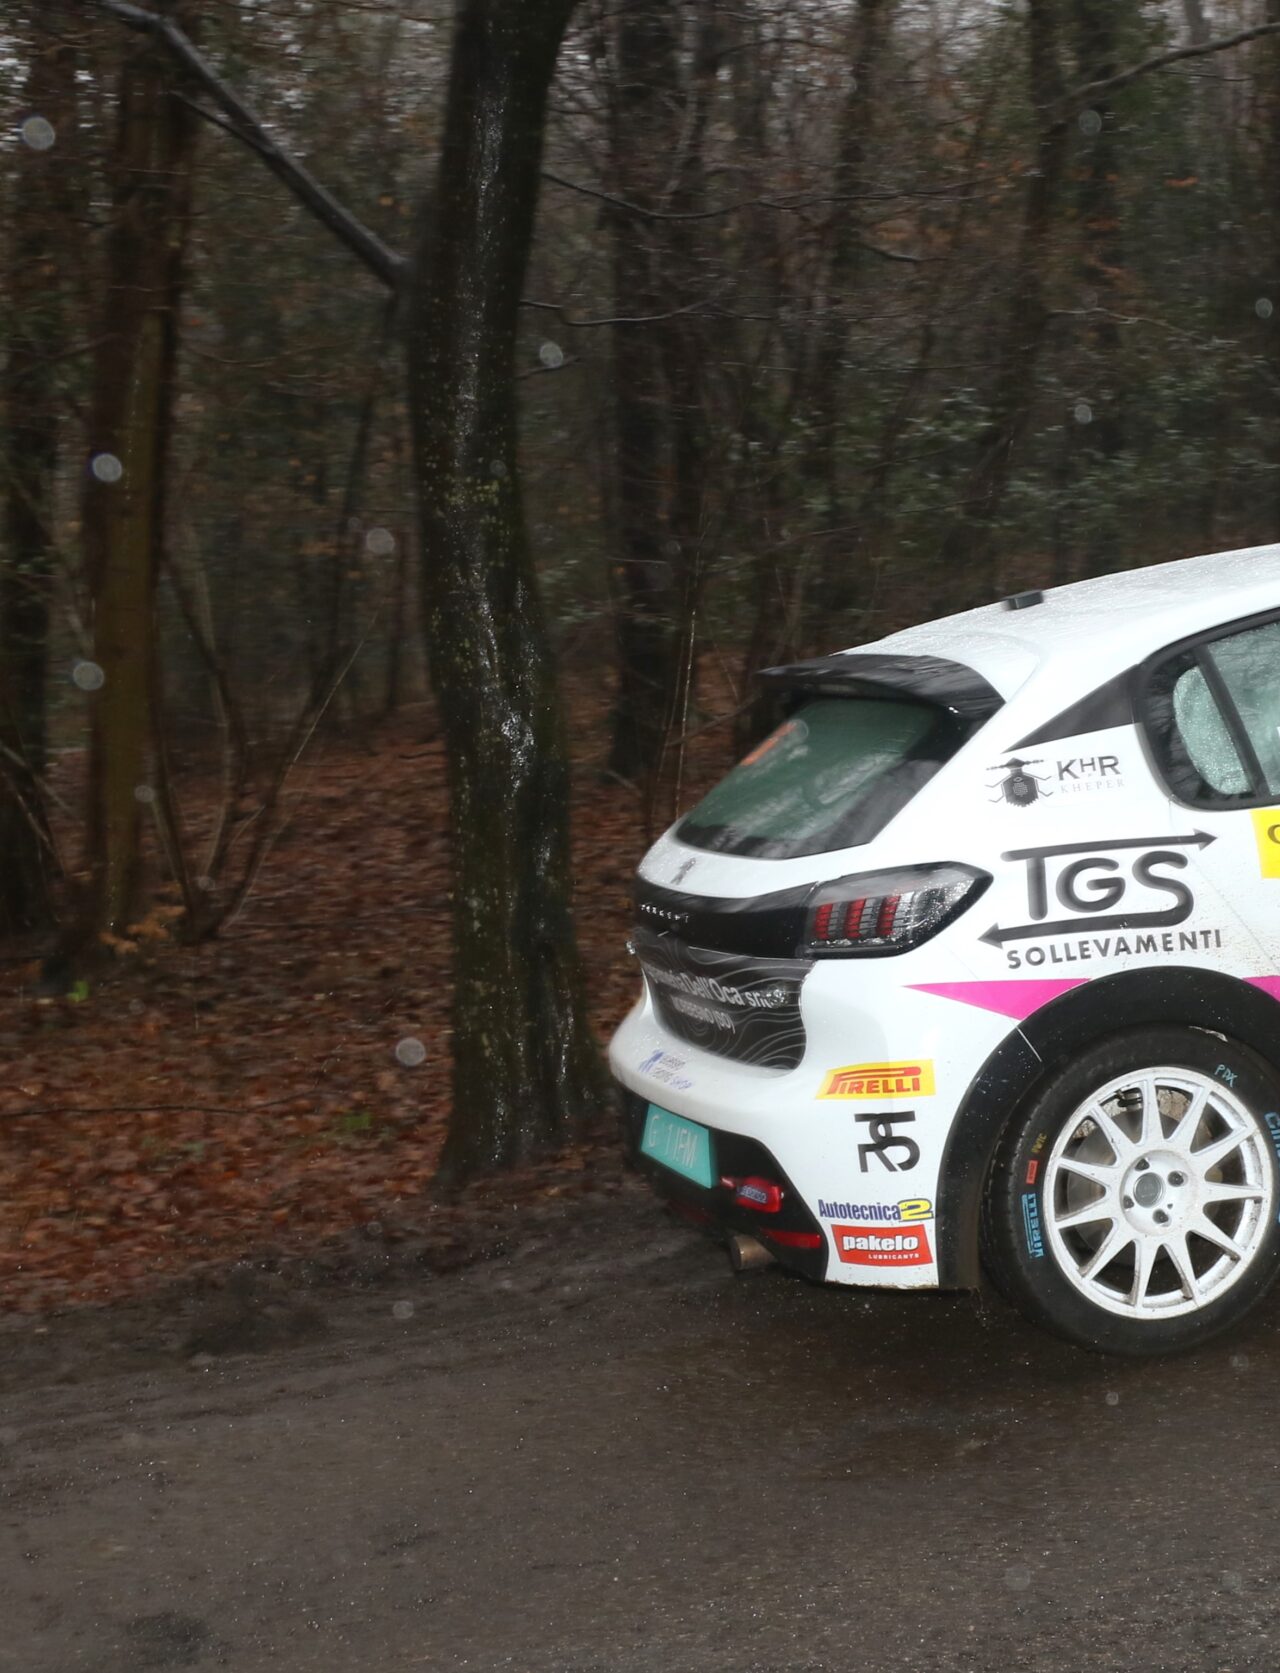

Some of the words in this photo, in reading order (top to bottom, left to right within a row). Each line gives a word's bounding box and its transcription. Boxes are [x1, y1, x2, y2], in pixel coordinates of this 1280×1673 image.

[1056, 755, 1121, 781] KHR
[1060, 778, 1125, 793] KHEPER
[1001, 840, 1195, 928] TGS
[1006, 929, 1223, 969] SOLLEVAMENTI
[826, 1066, 922, 1095] PIRELLI
[1021, 1193, 1045, 1259] PIRELLI
[842, 1234, 919, 1251] pakelo
